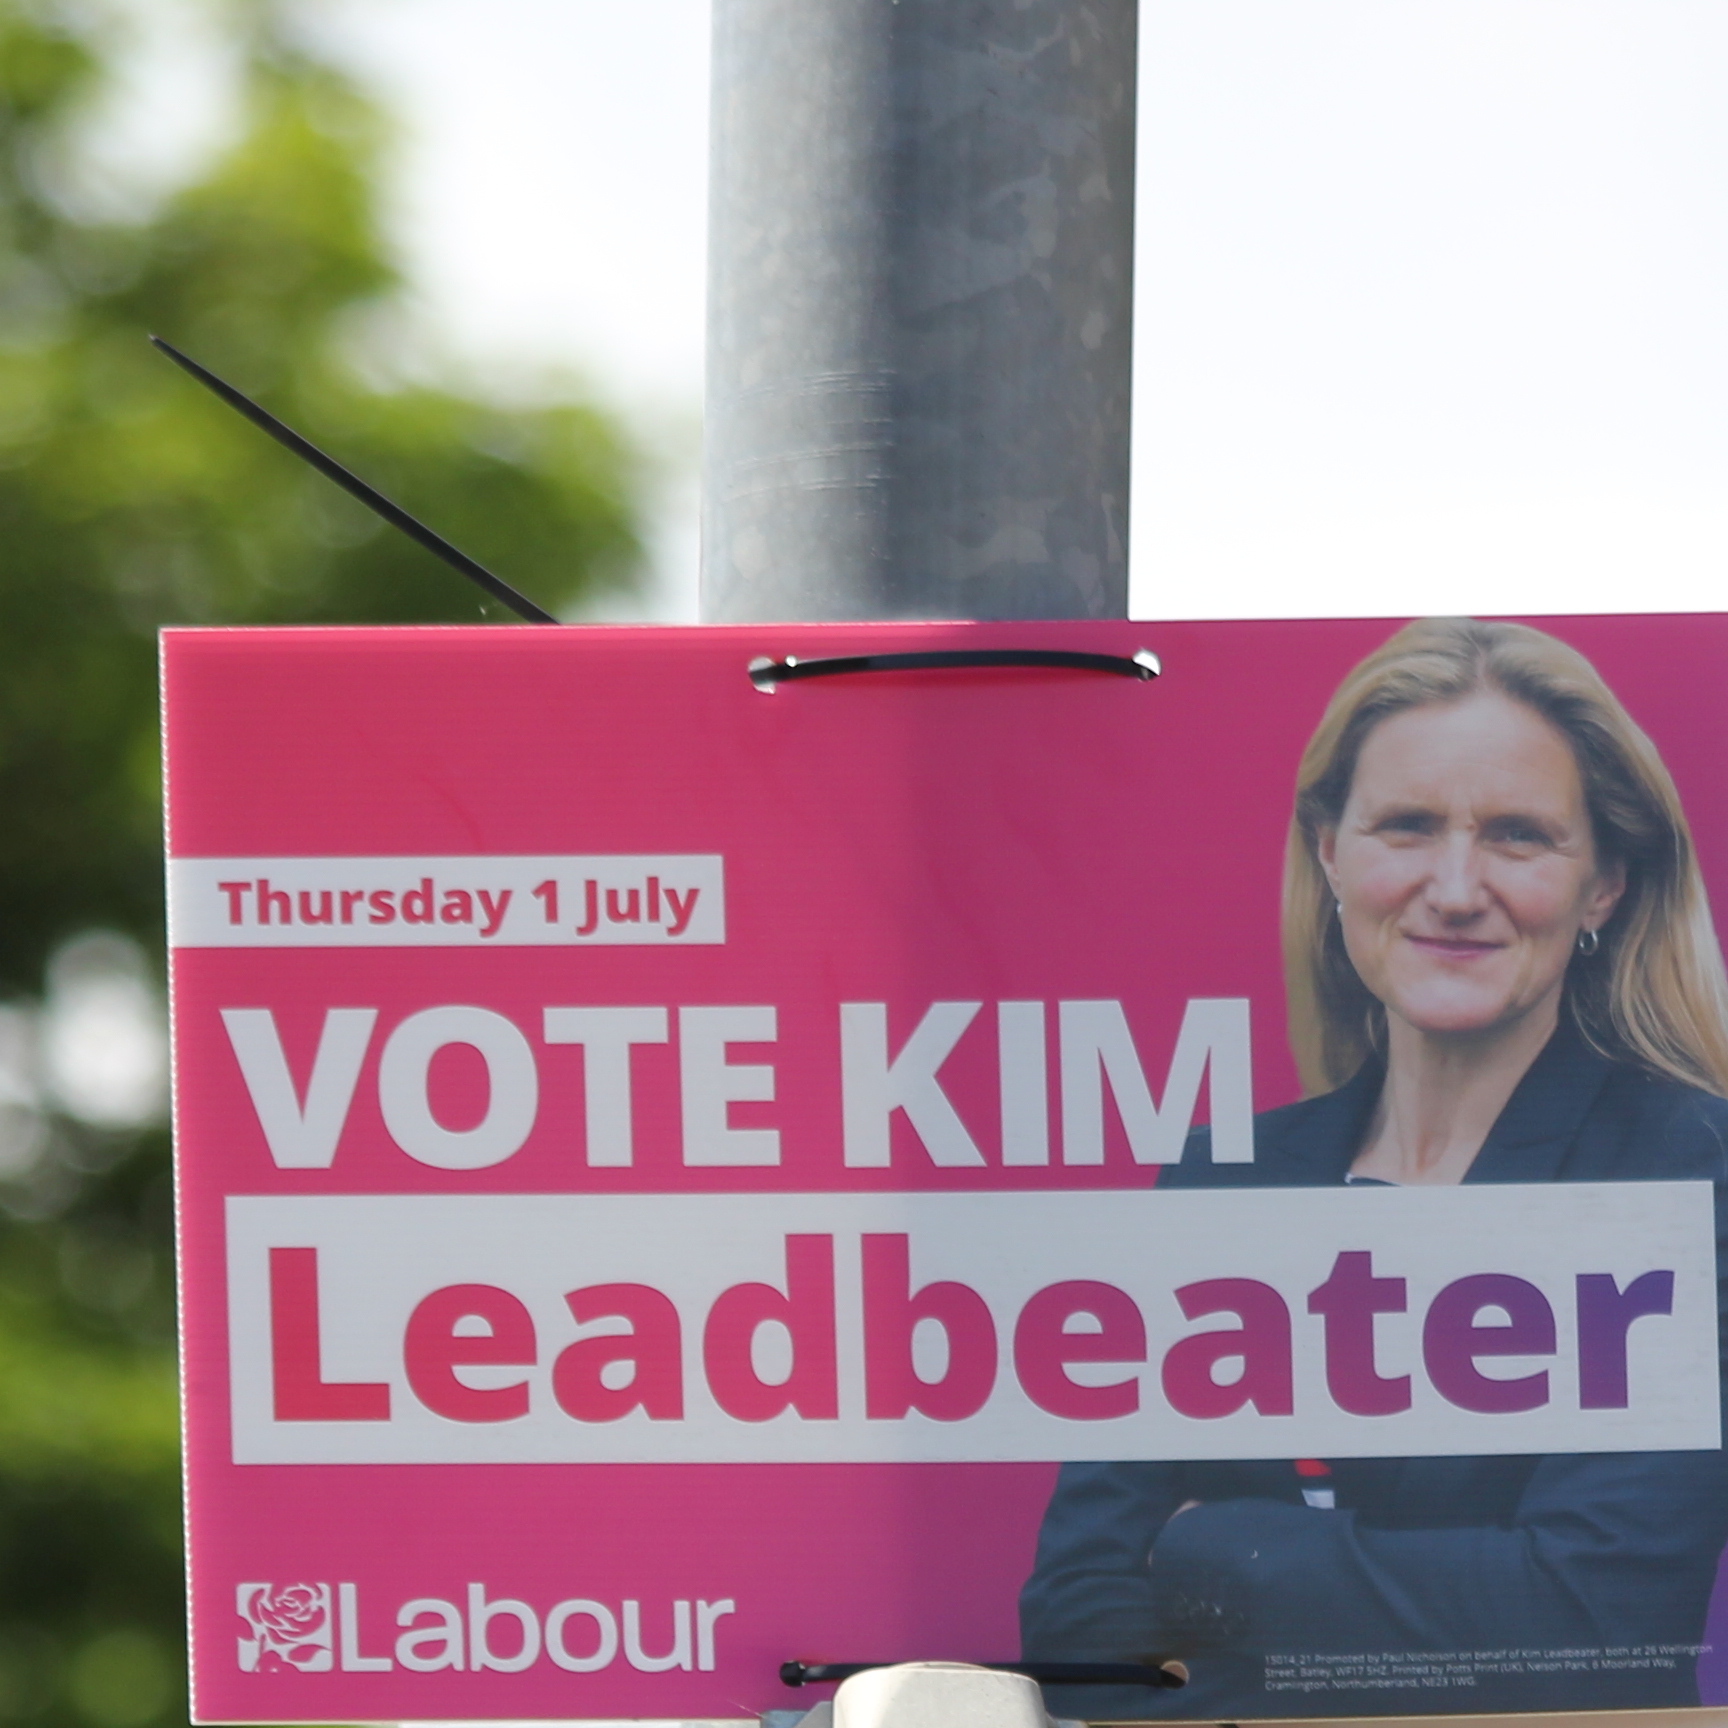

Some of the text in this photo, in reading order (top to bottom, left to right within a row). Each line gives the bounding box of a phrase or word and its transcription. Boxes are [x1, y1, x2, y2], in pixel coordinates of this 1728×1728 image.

[220, 876, 700, 938] Thursday 1 July
[219, 997, 1255, 1170] VOTE KIM
[270, 1233, 1675, 1423] Leadbeater
[338, 1582, 736, 1673] Labour
[1315, 1654, 1365, 1664] Promoted
[1367, 1654, 1380, 1665] by
[1382, 1652, 1404, 1662] Paul
[1406, 1651, 1457, 1662] Nicholson
[1459, 1653, 1472, 1661] on
[1474, 1649, 1509, 1660] behalf
[1509, 1649, 1520, 1659] of
[1522, 1649, 1541, 1658] Kim
[1605, 1647, 1629, 1657] both
[1631, 1648, 1642, 1656] at
[1659, 1644, 1712, 1657] Wellington
[1335, 1666, 1364, 1676] WF17
[1392, 1665, 1429, 1675] Printed
[1431, 1664, 1444, 1675] by
[1446, 1664, 1471, 1674] Potts
[1474, 1662, 1498, 1672] Print
[1527, 1661, 1562, 1671] Nelson
[1601, 1658, 1650, 1669] Moorland
